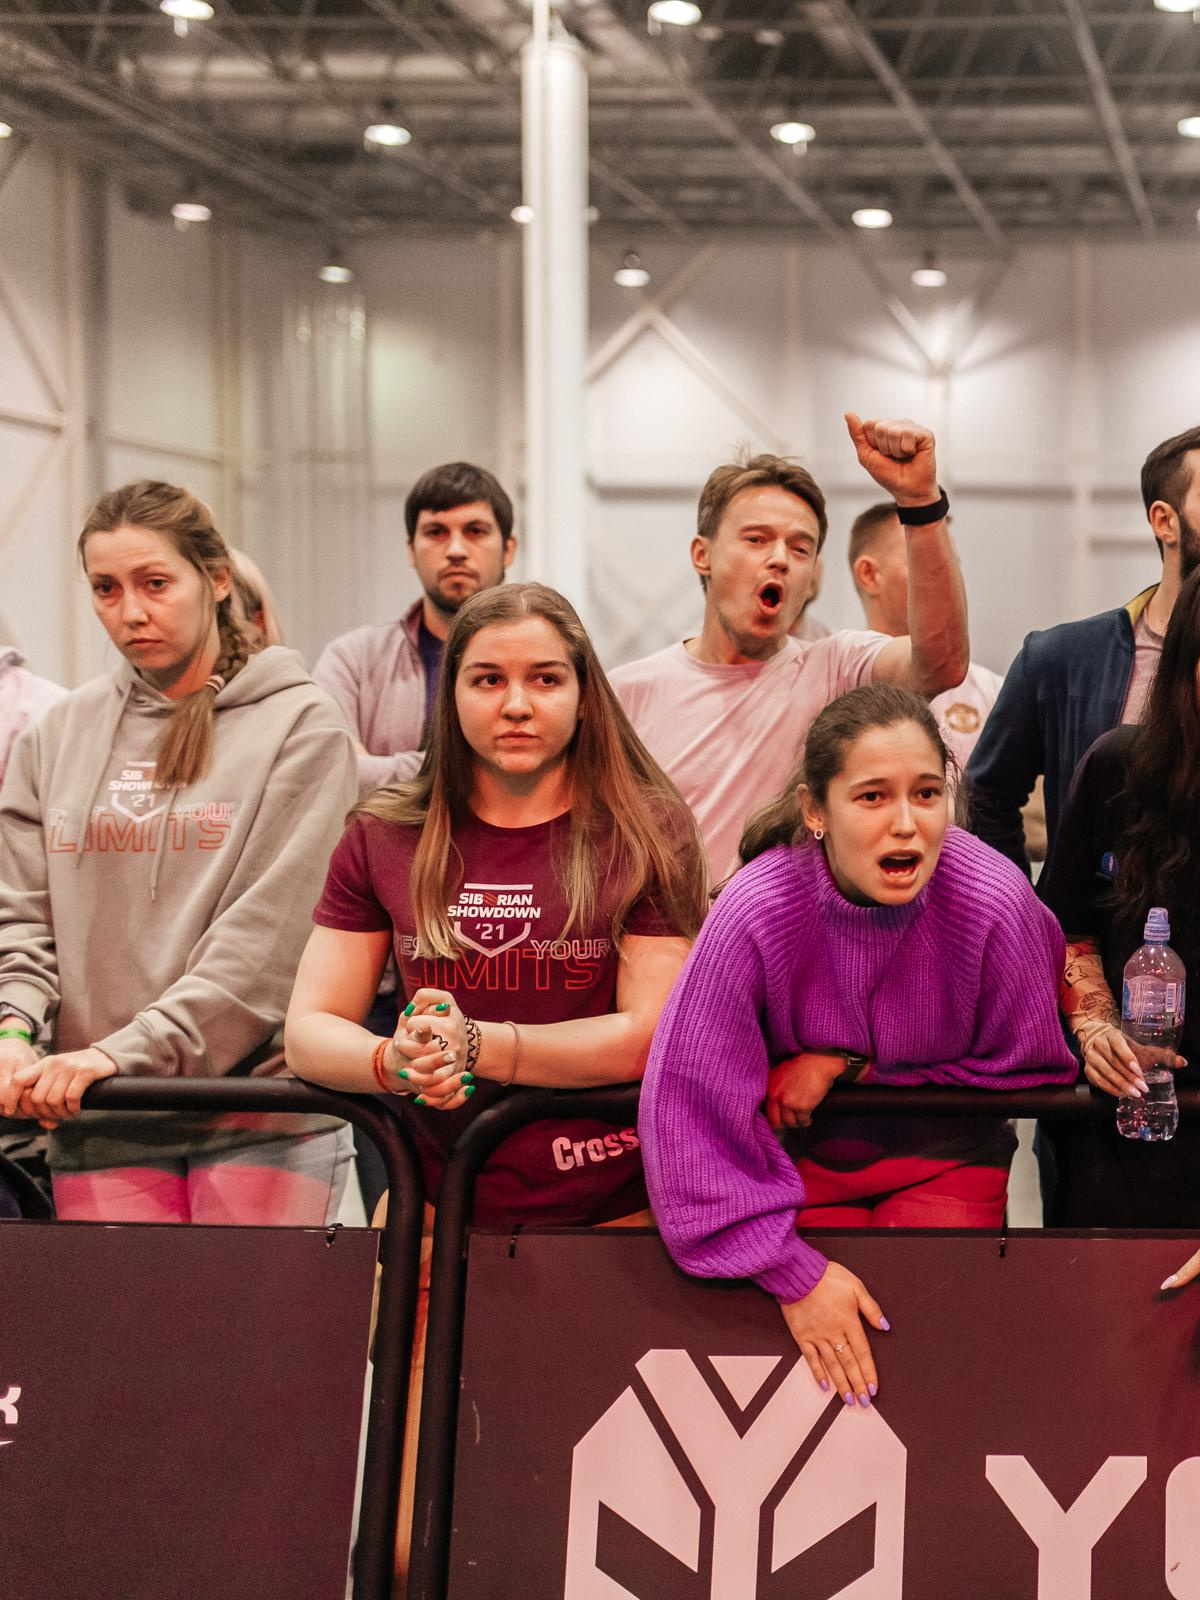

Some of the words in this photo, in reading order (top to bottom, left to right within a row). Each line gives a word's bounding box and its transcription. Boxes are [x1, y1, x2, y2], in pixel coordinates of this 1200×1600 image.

[458, 892, 534, 906] SIBRIAN
[446, 905, 542, 919] SHOWDOWN
[530, 938, 612, 961] YOUR
